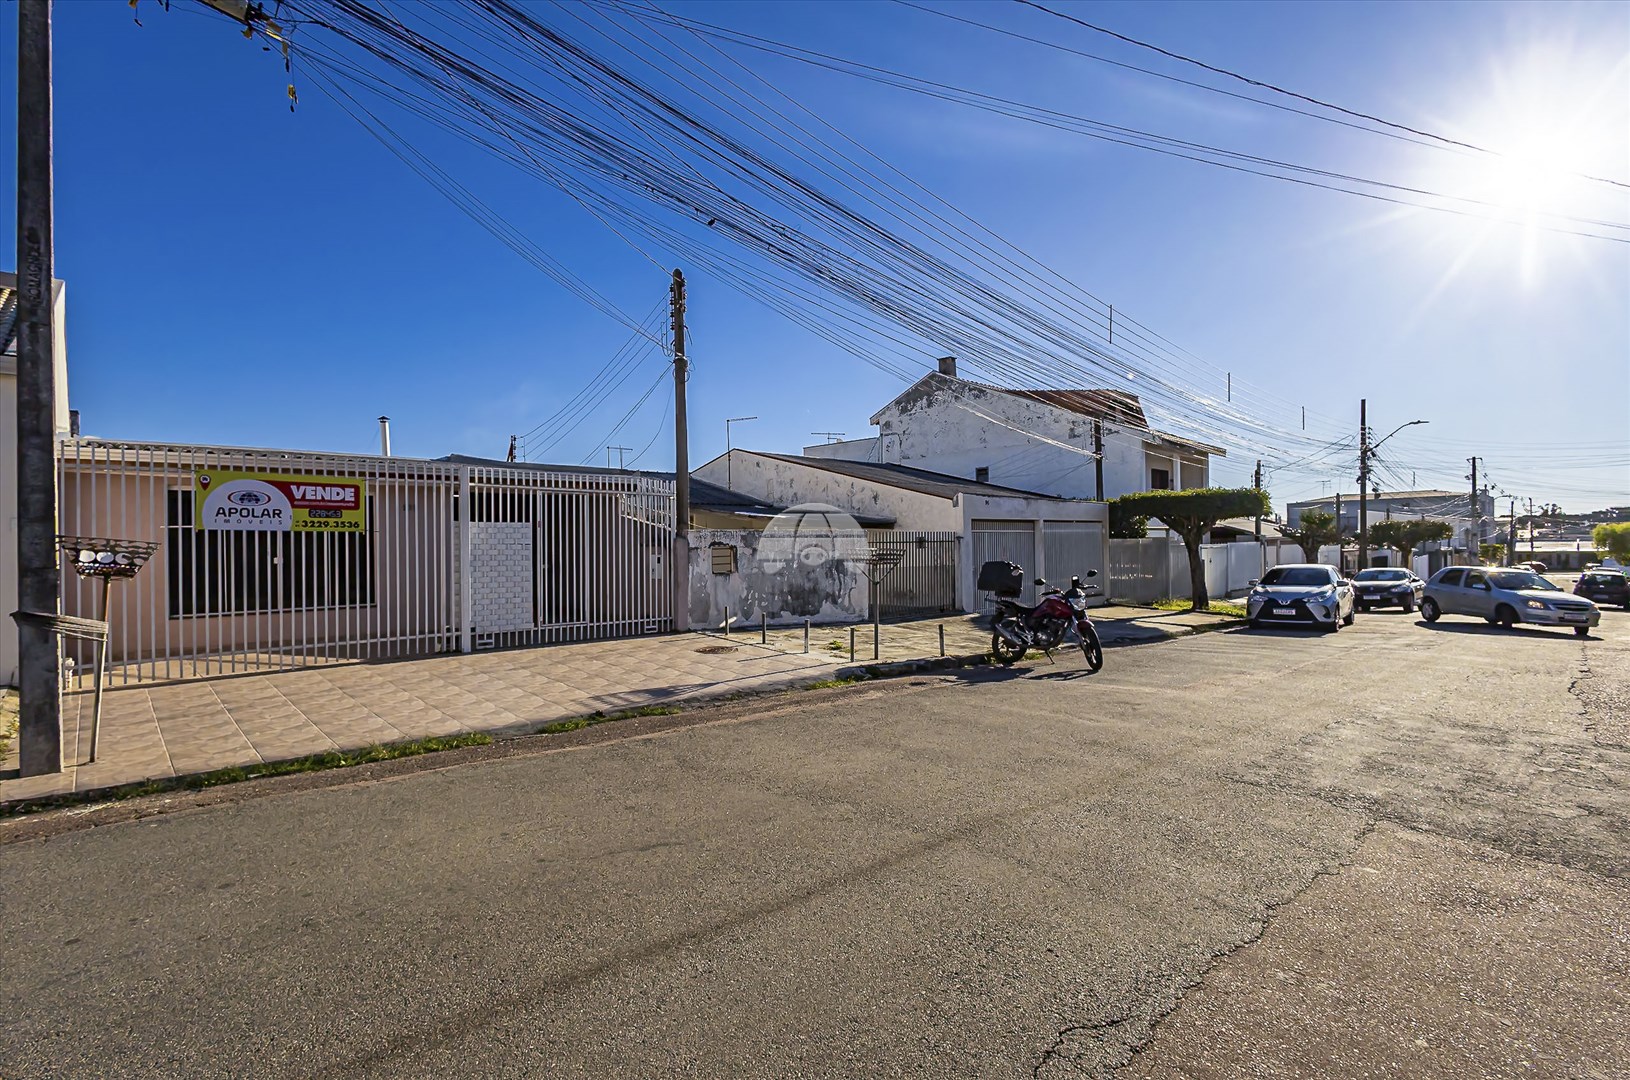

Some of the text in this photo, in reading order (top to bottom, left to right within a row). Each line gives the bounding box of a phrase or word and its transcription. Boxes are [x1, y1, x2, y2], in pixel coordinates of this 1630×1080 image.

[290, 485, 355, 501] VENDE
[215, 506, 283, 519] APOLAR
[301, 520, 360, 529] 3229.3536
